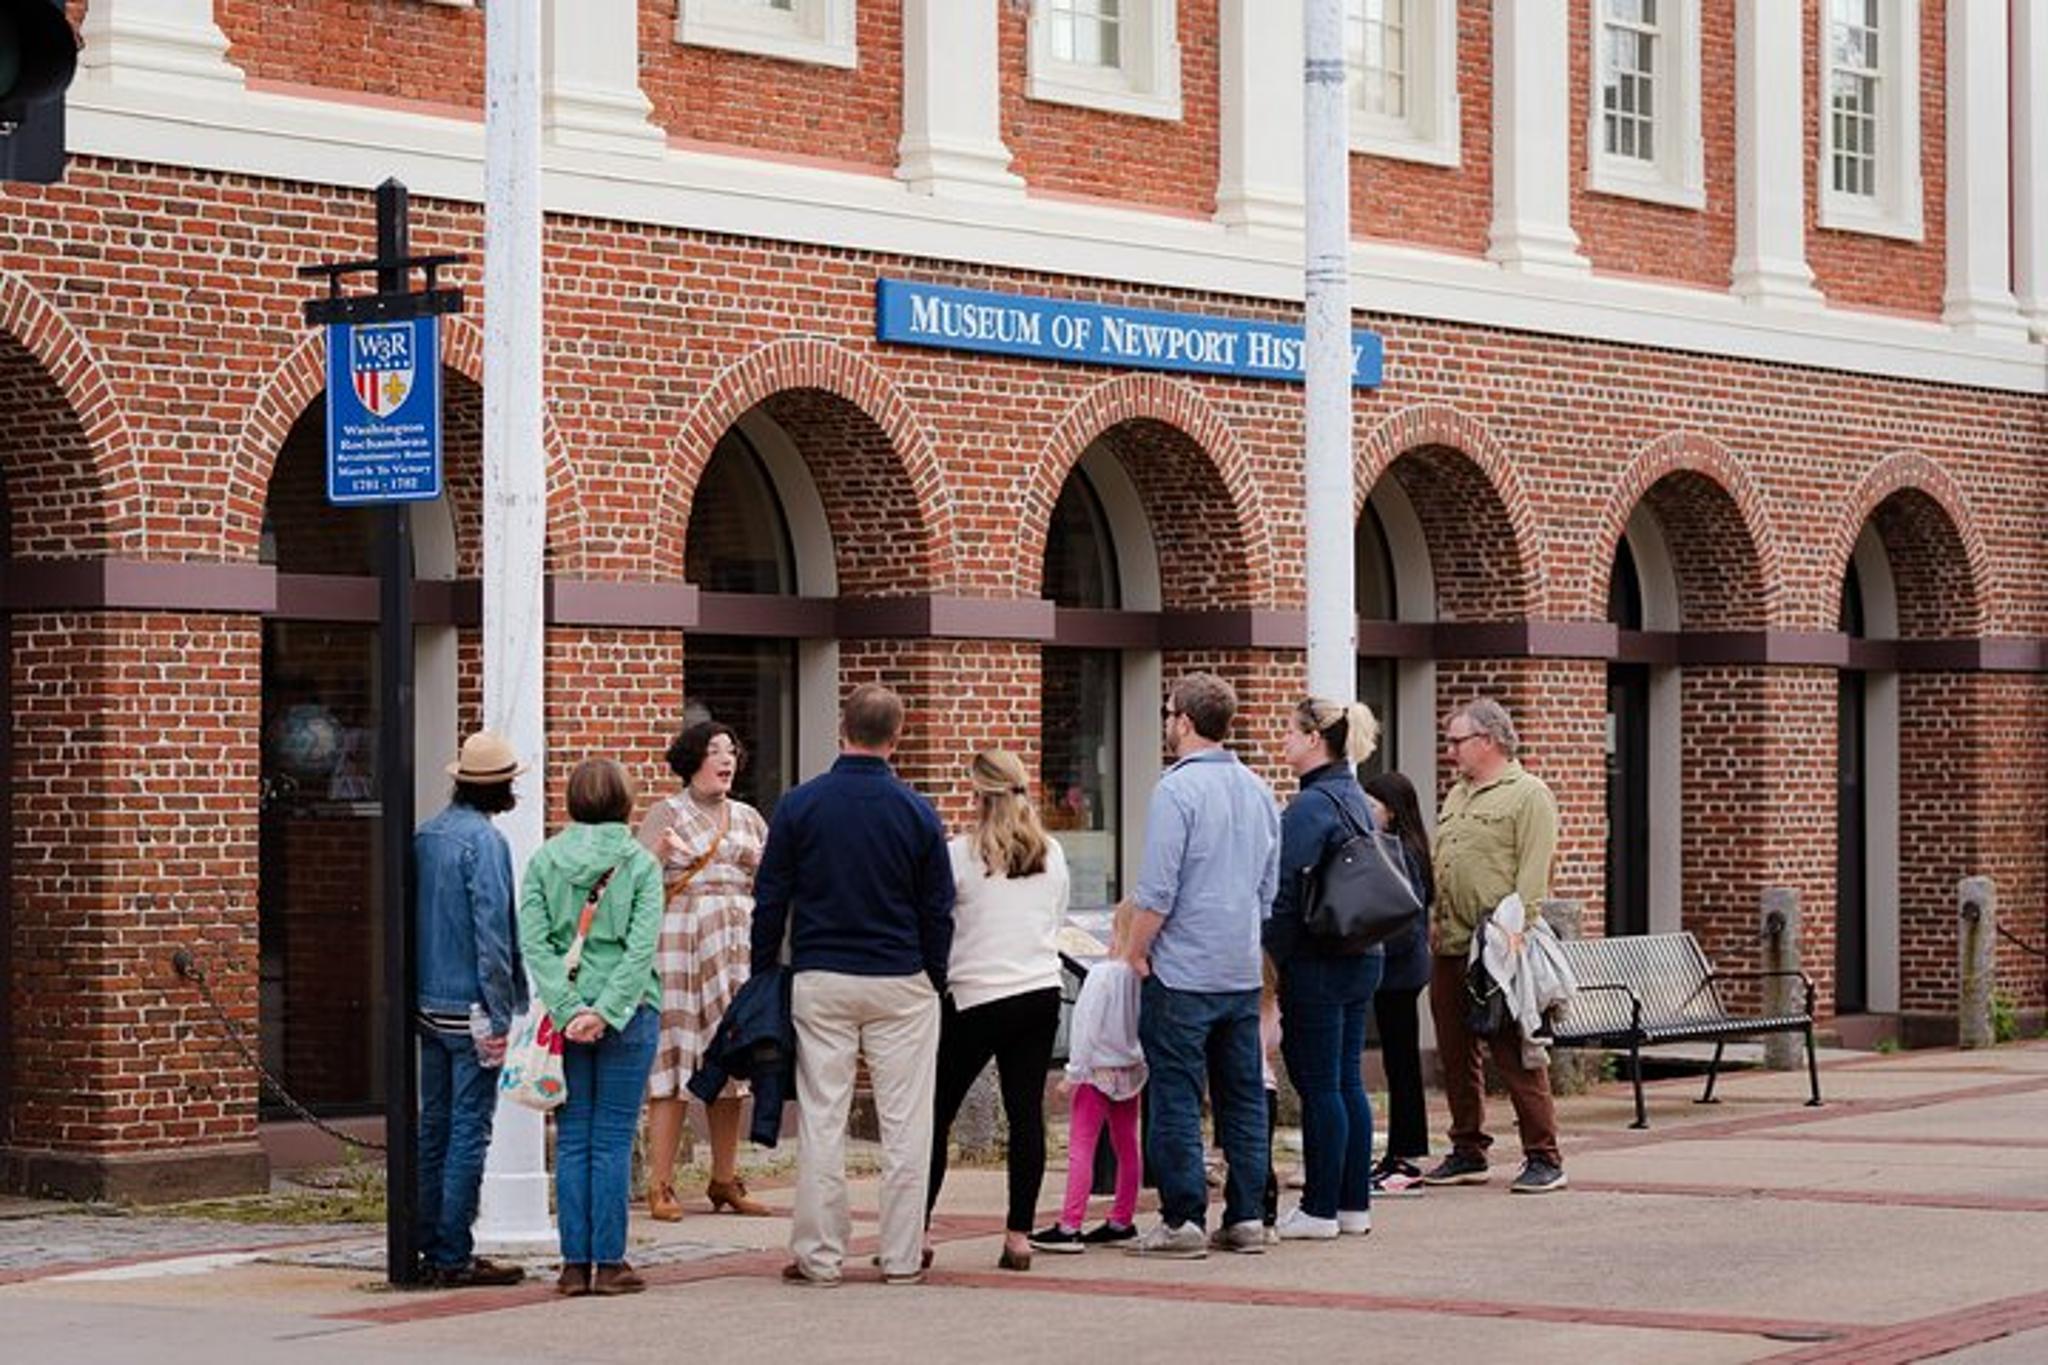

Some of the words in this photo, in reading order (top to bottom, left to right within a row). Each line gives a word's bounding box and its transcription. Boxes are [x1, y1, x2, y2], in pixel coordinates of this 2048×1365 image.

[910, 293, 1042, 346] MUSEUM
[1051, 314, 1091, 350] OF
[1101, 315, 1239, 365] NEWPORT
